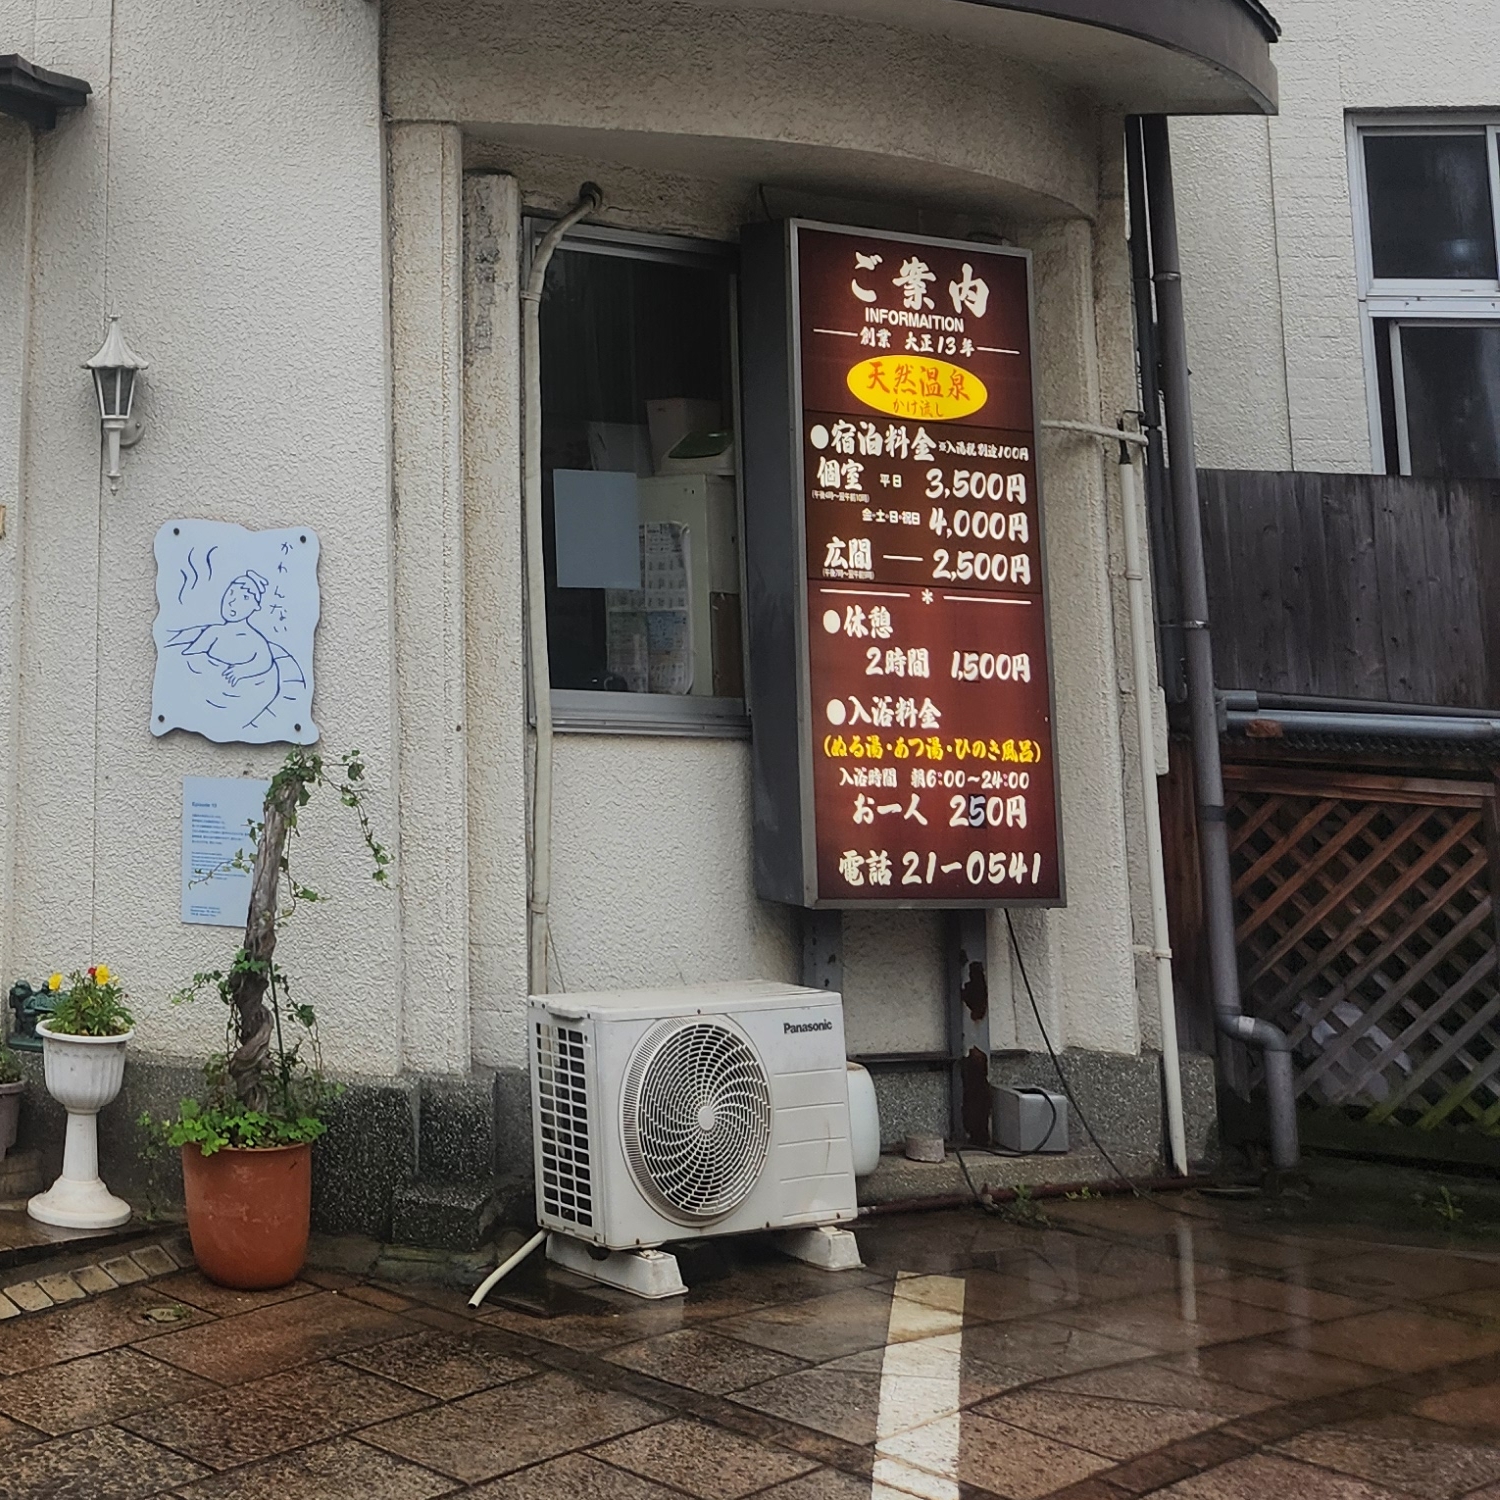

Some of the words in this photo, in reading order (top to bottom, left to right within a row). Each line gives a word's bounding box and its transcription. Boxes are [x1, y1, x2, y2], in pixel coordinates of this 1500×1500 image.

[852, 251, 989, 318] ご案内
[865, 307, 964, 333] INFORMAITION
[860, 327, 892, 349] 創業
[905, 331, 975, 357] 大正13年
[867, 361, 970, 401] 天然温泉
[892, 398, 944, 418] かけ流し
[816, 456, 865, 491] 個室
[879, 473, 902, 488] 平日
[925, 468, 1027, 504] 3,500円
[929, 507, 1029, 544] 4,000円
[823, 536, 873, 570] 広間
[932, 548, 1031, 585] 2,500円
[844, 604, 894, 639] 休憩
[865, 646, 930, 678] 2時間
[951, 650, 1031, 683] 1,500円
[848, 695, 942, 729] 入浴料金
[839, 767, 897, 788] 入浴時間
[852, 793, 928, 826] お一人
[949, 794, 1028, 829] 250円
[838, 850, 893, 886] 電話
[783, 1018, 832, 1034] Panasonic
